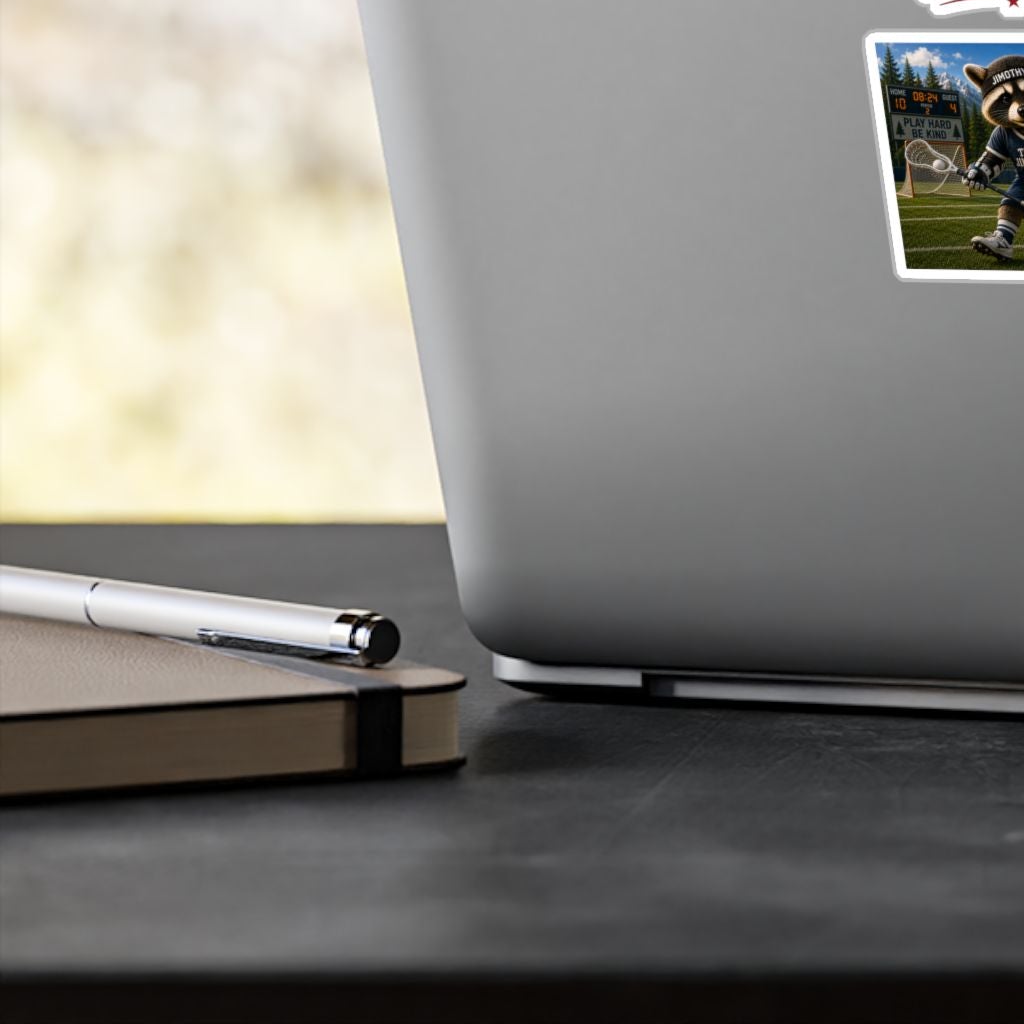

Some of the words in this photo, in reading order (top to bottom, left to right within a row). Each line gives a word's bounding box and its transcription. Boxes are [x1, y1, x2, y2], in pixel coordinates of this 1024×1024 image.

[895, 97, 907, 111] 10
[949, 103, 957, 113] 4
[903, 117, 925, 128] PLAY
[928, 118, 952, 129] HARD
[912, 128, 923, 138] BE
[926, 129, 947, 139] KIND
